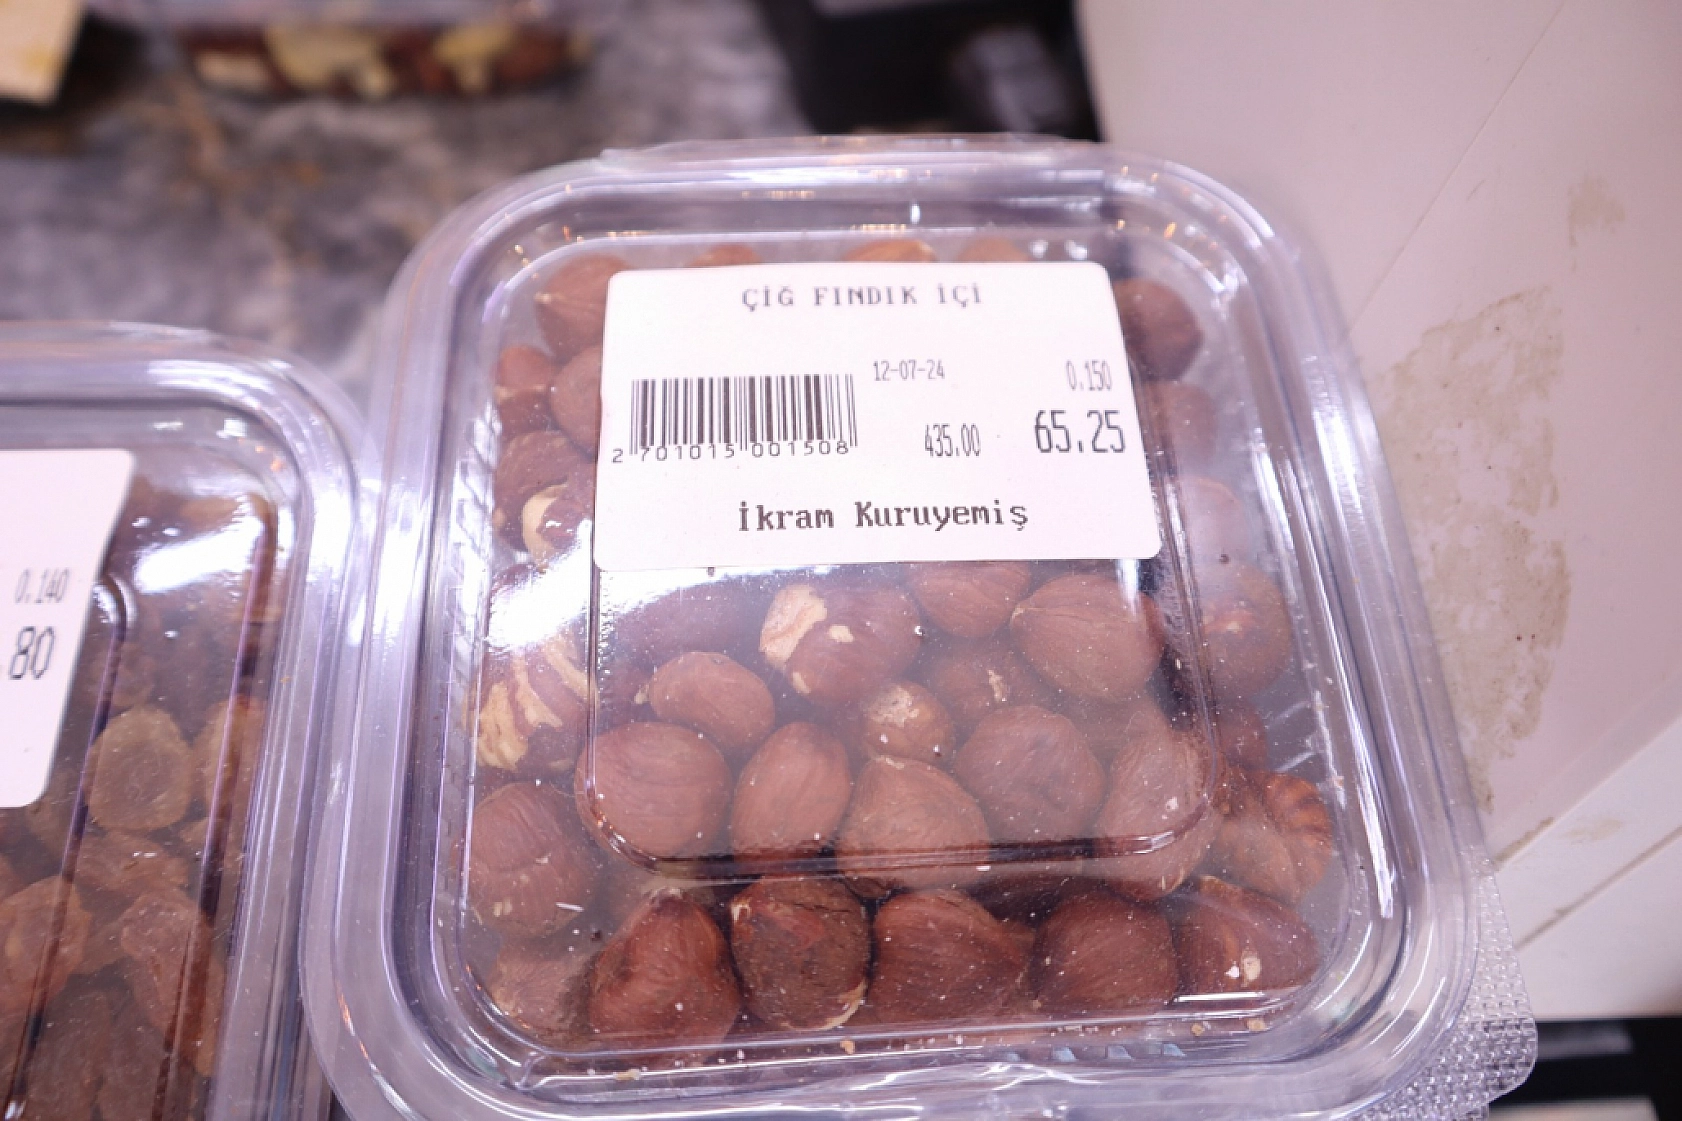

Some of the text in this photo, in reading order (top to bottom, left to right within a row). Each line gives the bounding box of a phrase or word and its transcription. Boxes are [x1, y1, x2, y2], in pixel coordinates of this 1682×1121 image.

[813, 285, 918, 306] FINDIK
[873, 358, 946, 382] 12-07-24
[1065, 359, 1113, 391] 0.150
[924, 422, 982, 458] 435.00
[1033, 409, 1127, 453] 65.25
[738, 498, 1029, 532] İkram Kuruyemiş
[15, 568, 70, 604] 0.140
[0, 626, 55, 680] 80
